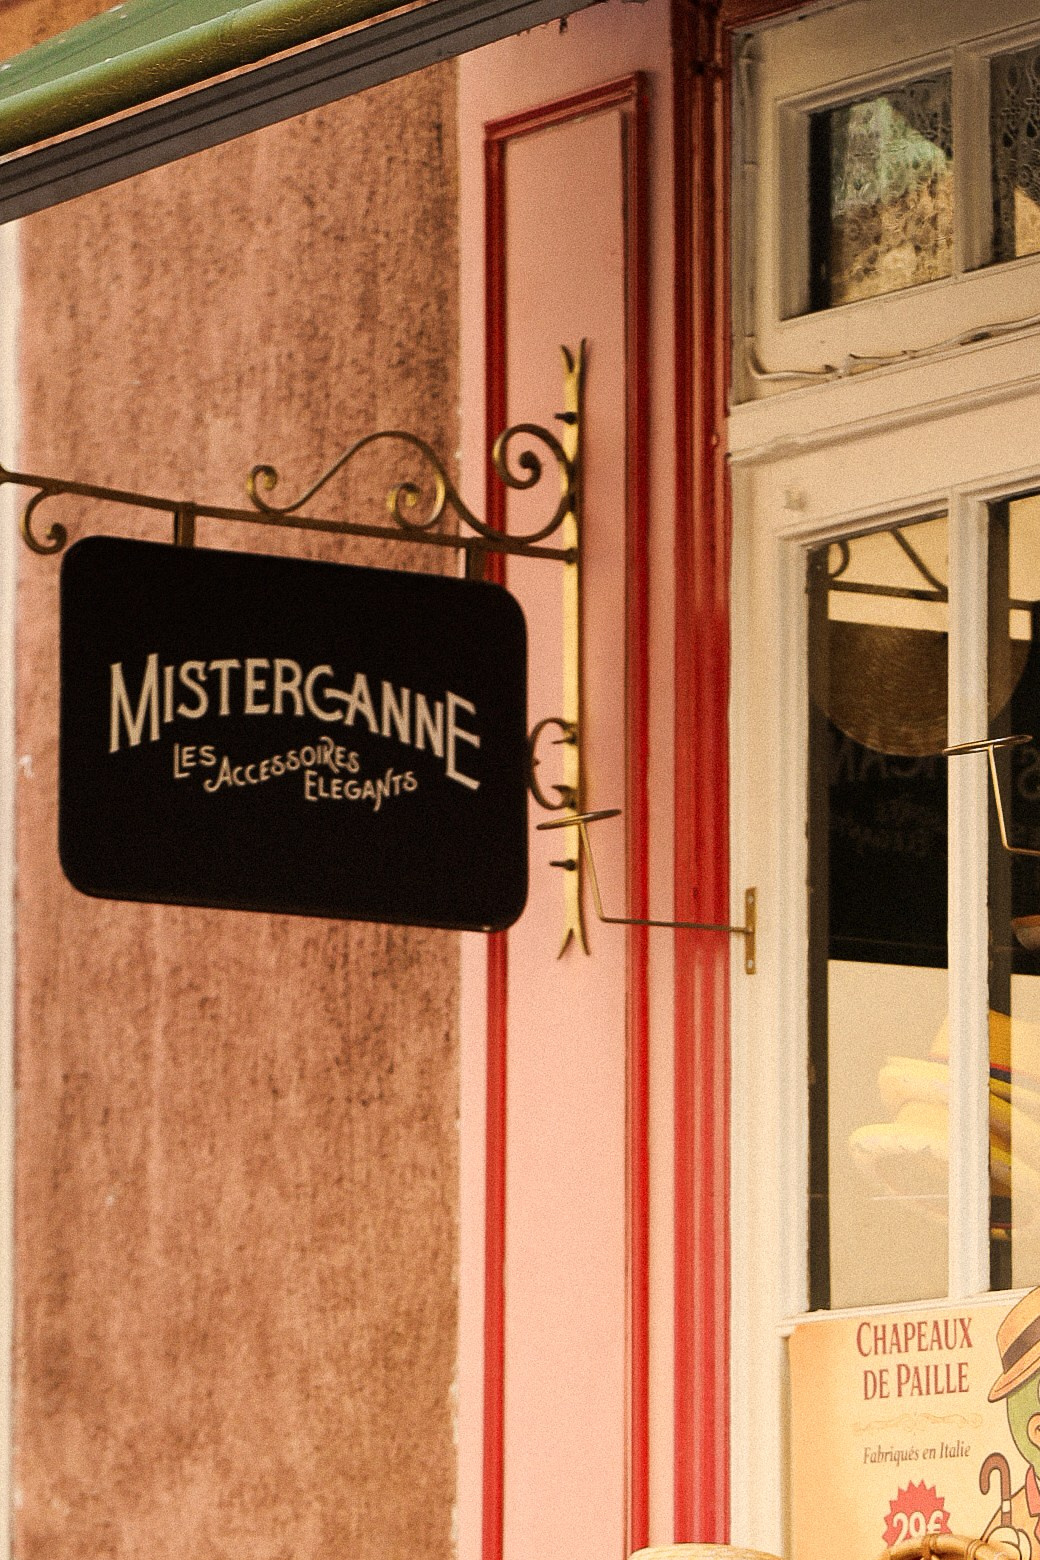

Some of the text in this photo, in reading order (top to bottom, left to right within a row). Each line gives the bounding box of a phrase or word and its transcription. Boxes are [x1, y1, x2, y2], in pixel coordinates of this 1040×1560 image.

[173, 736, 360, 792] LES ACCESSOIRES
[304, 768, 418, 812] ELEGANTS
[856, 1317, 973, 1357] CHAPEAUX
[863, 1362, 970, 1400] DE PAILLE
[863, 1440, 971, 1467] Fabriqués en Italie
